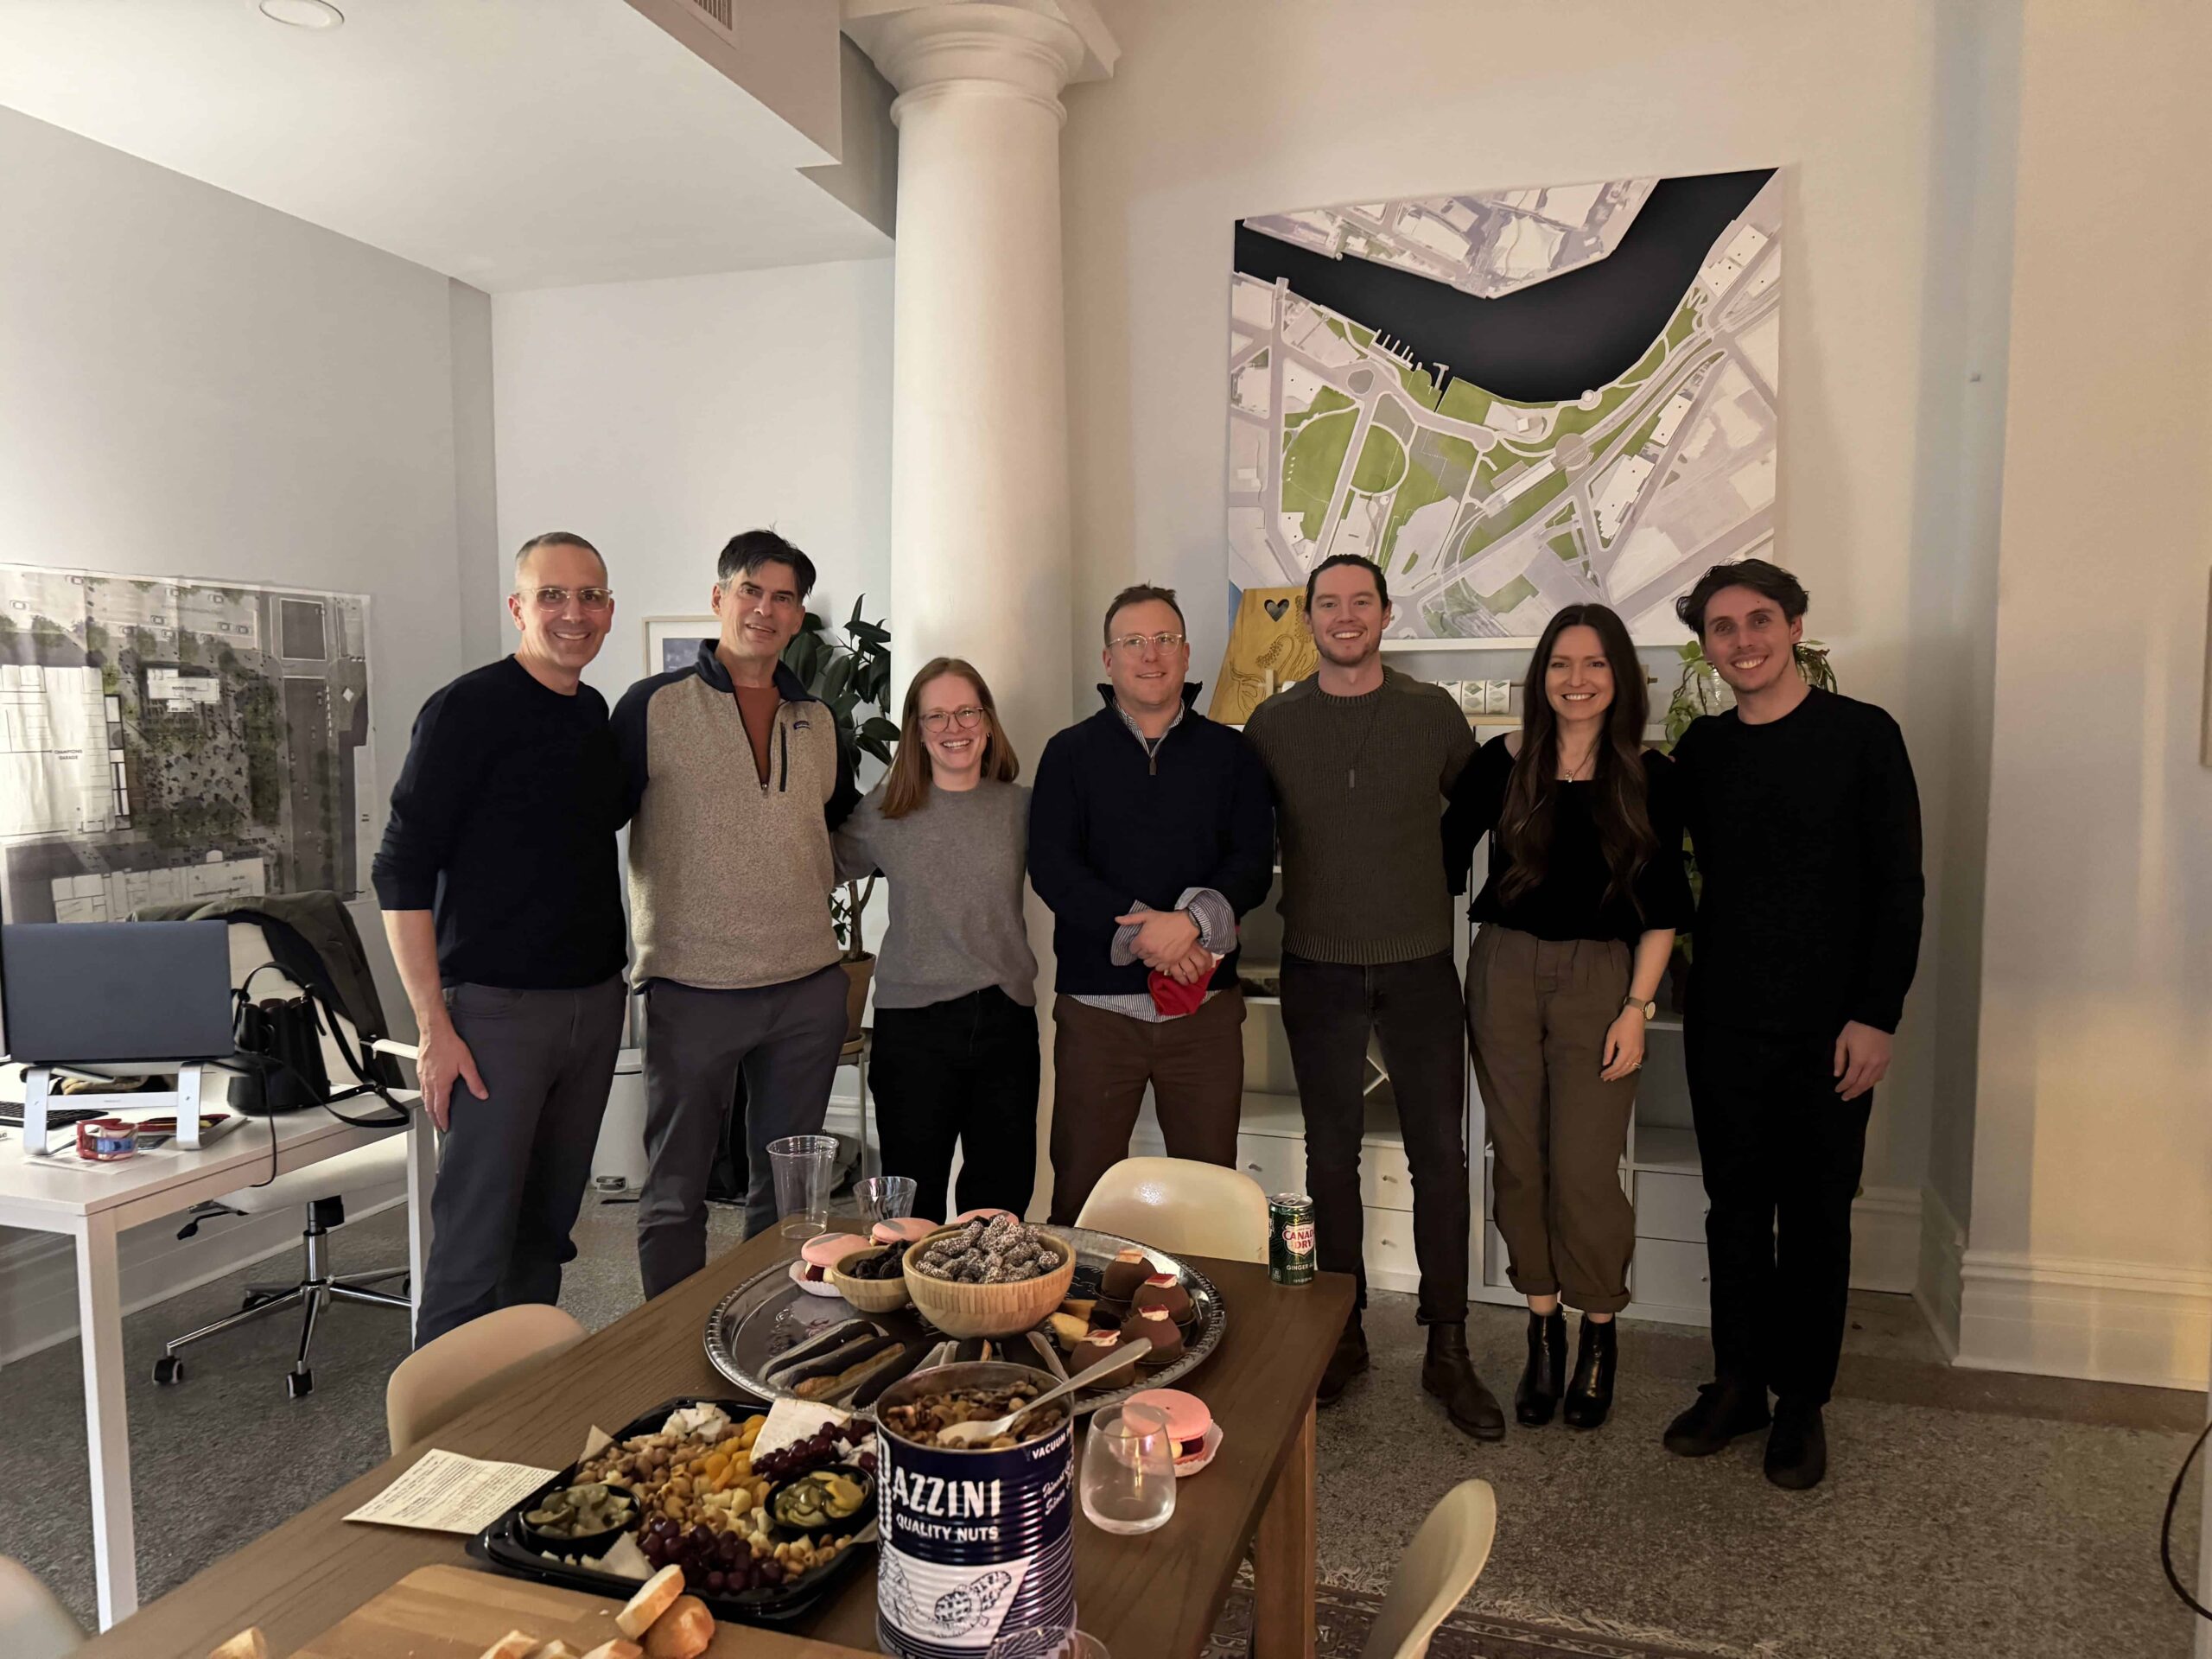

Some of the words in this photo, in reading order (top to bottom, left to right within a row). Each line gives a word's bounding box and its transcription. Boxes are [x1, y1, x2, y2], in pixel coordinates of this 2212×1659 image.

[1283, 1229, 1314, 1241] CANAD
[1294, 1238, 1313, 1249] DRY
[1032, 1432, 1066, 1460] VACUUM
[895, 1512, 952, 1541] QUALITY
[957, 1525, 1000, 1542] NUTS
